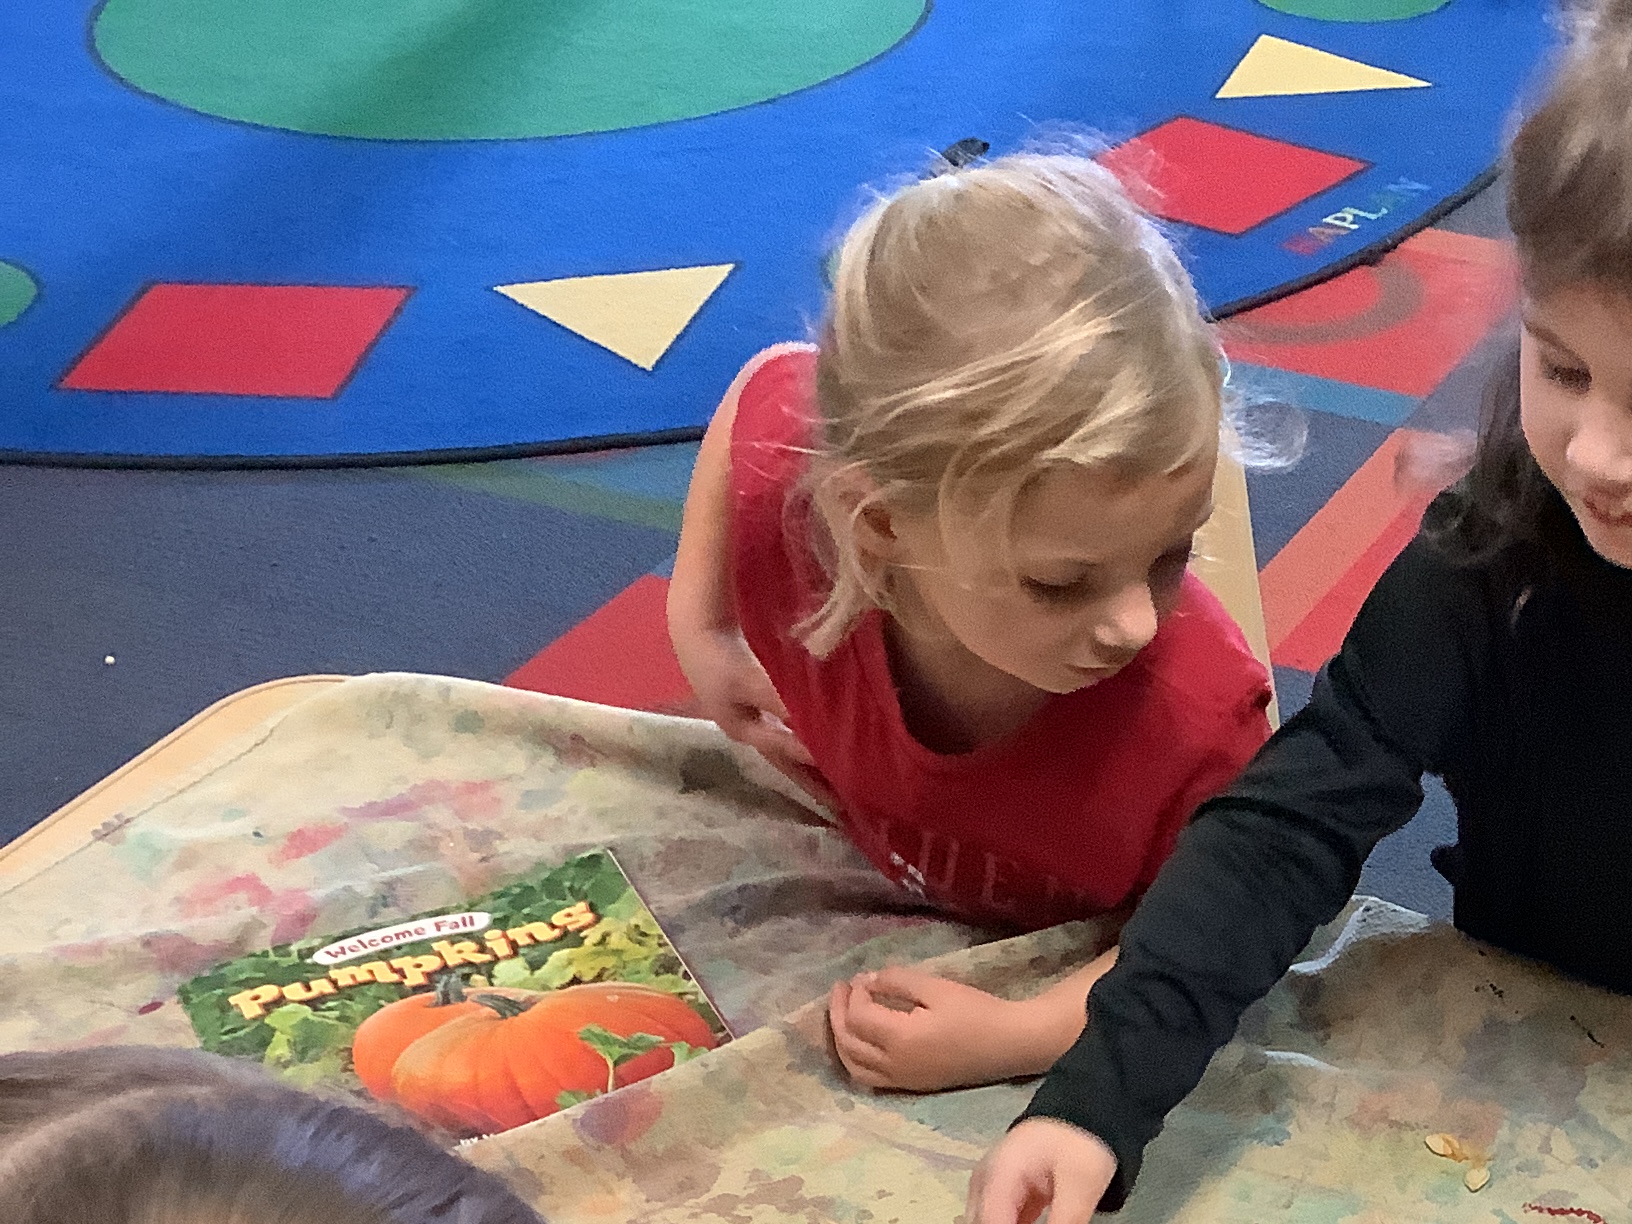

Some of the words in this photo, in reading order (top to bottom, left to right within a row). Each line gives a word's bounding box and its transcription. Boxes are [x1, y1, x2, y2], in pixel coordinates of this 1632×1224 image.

[227, 901, 601, 1021] Pumpkins
[324, 925, 426, 959] Welcome
[434, 915, 476, 933] Fall
